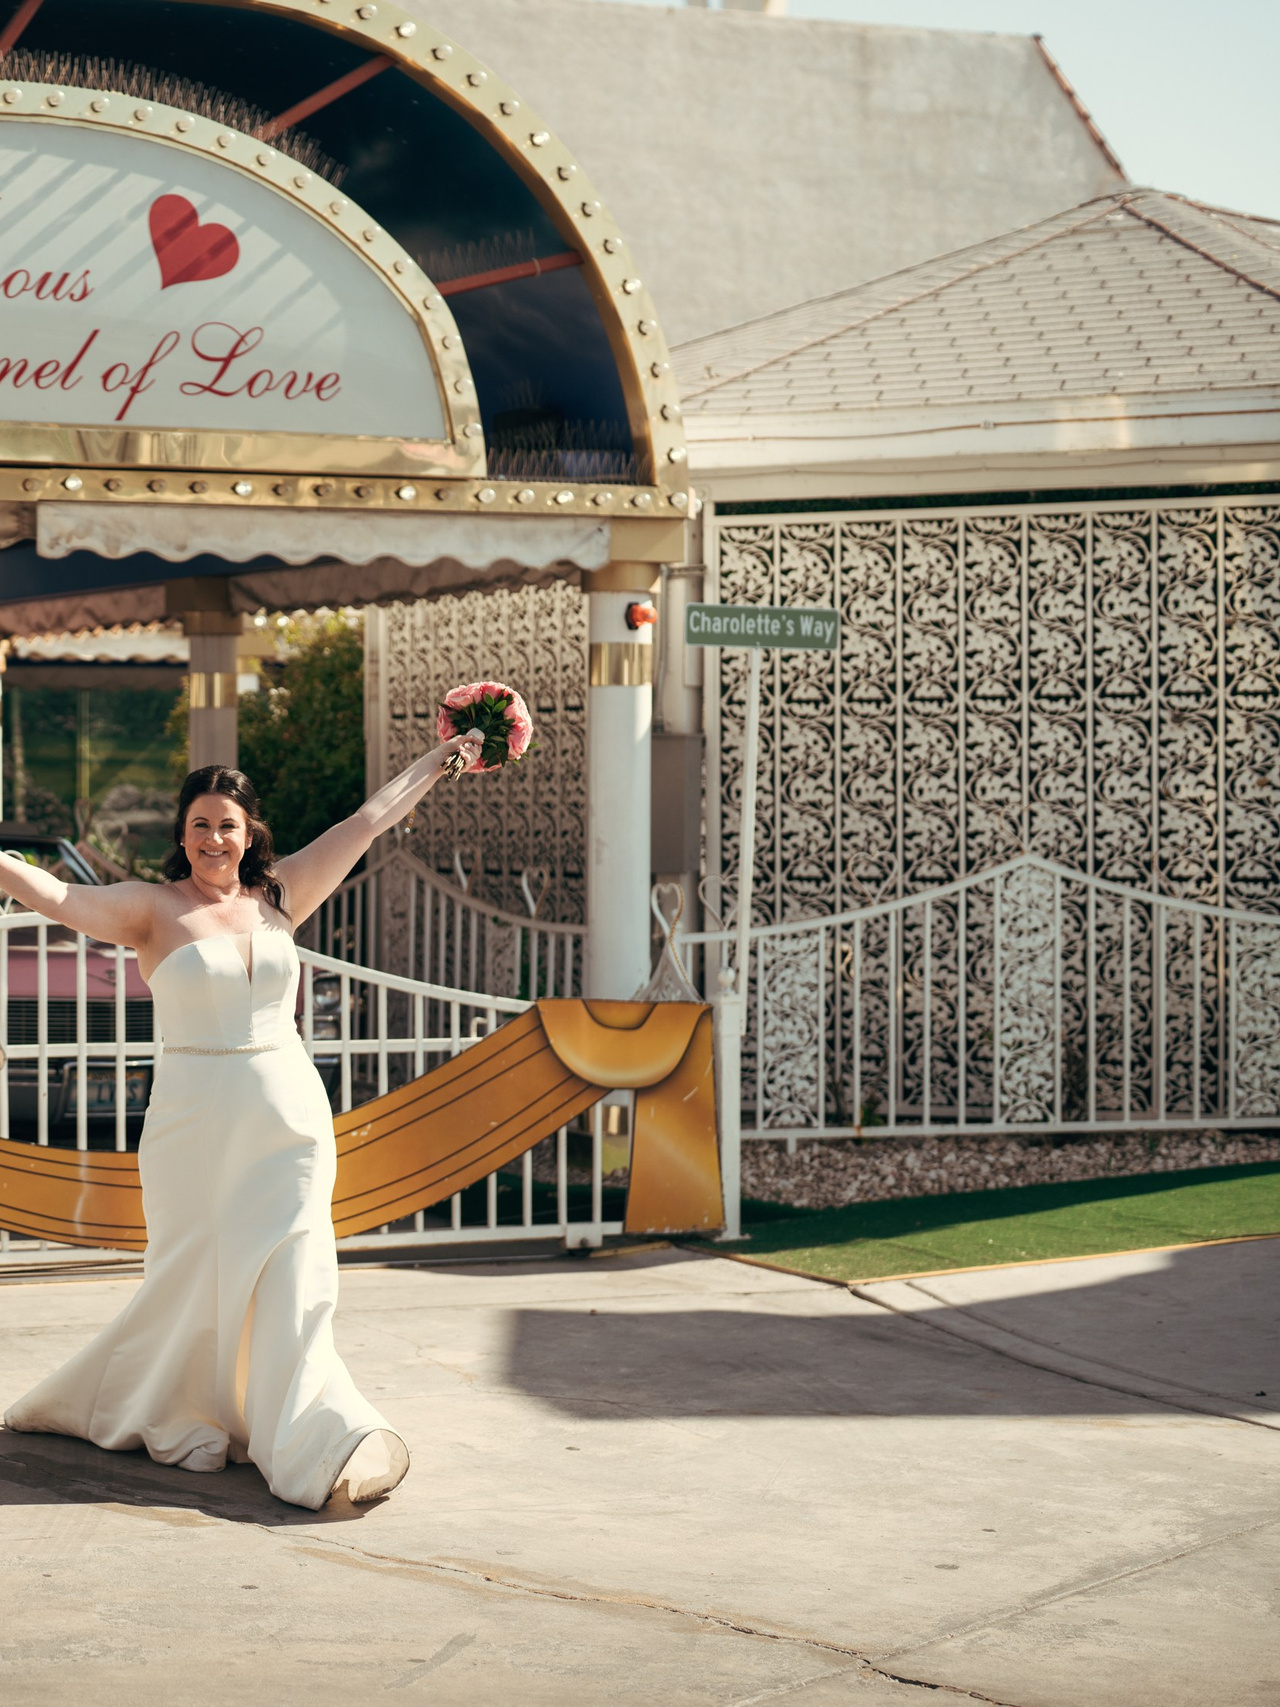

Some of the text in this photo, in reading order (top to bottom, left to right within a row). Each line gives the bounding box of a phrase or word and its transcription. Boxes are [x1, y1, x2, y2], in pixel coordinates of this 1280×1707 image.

[100, 329, 181, 421] of
[178, 320, 342, 401] Love
[689, 610, 835, 644] Charolette's Way
